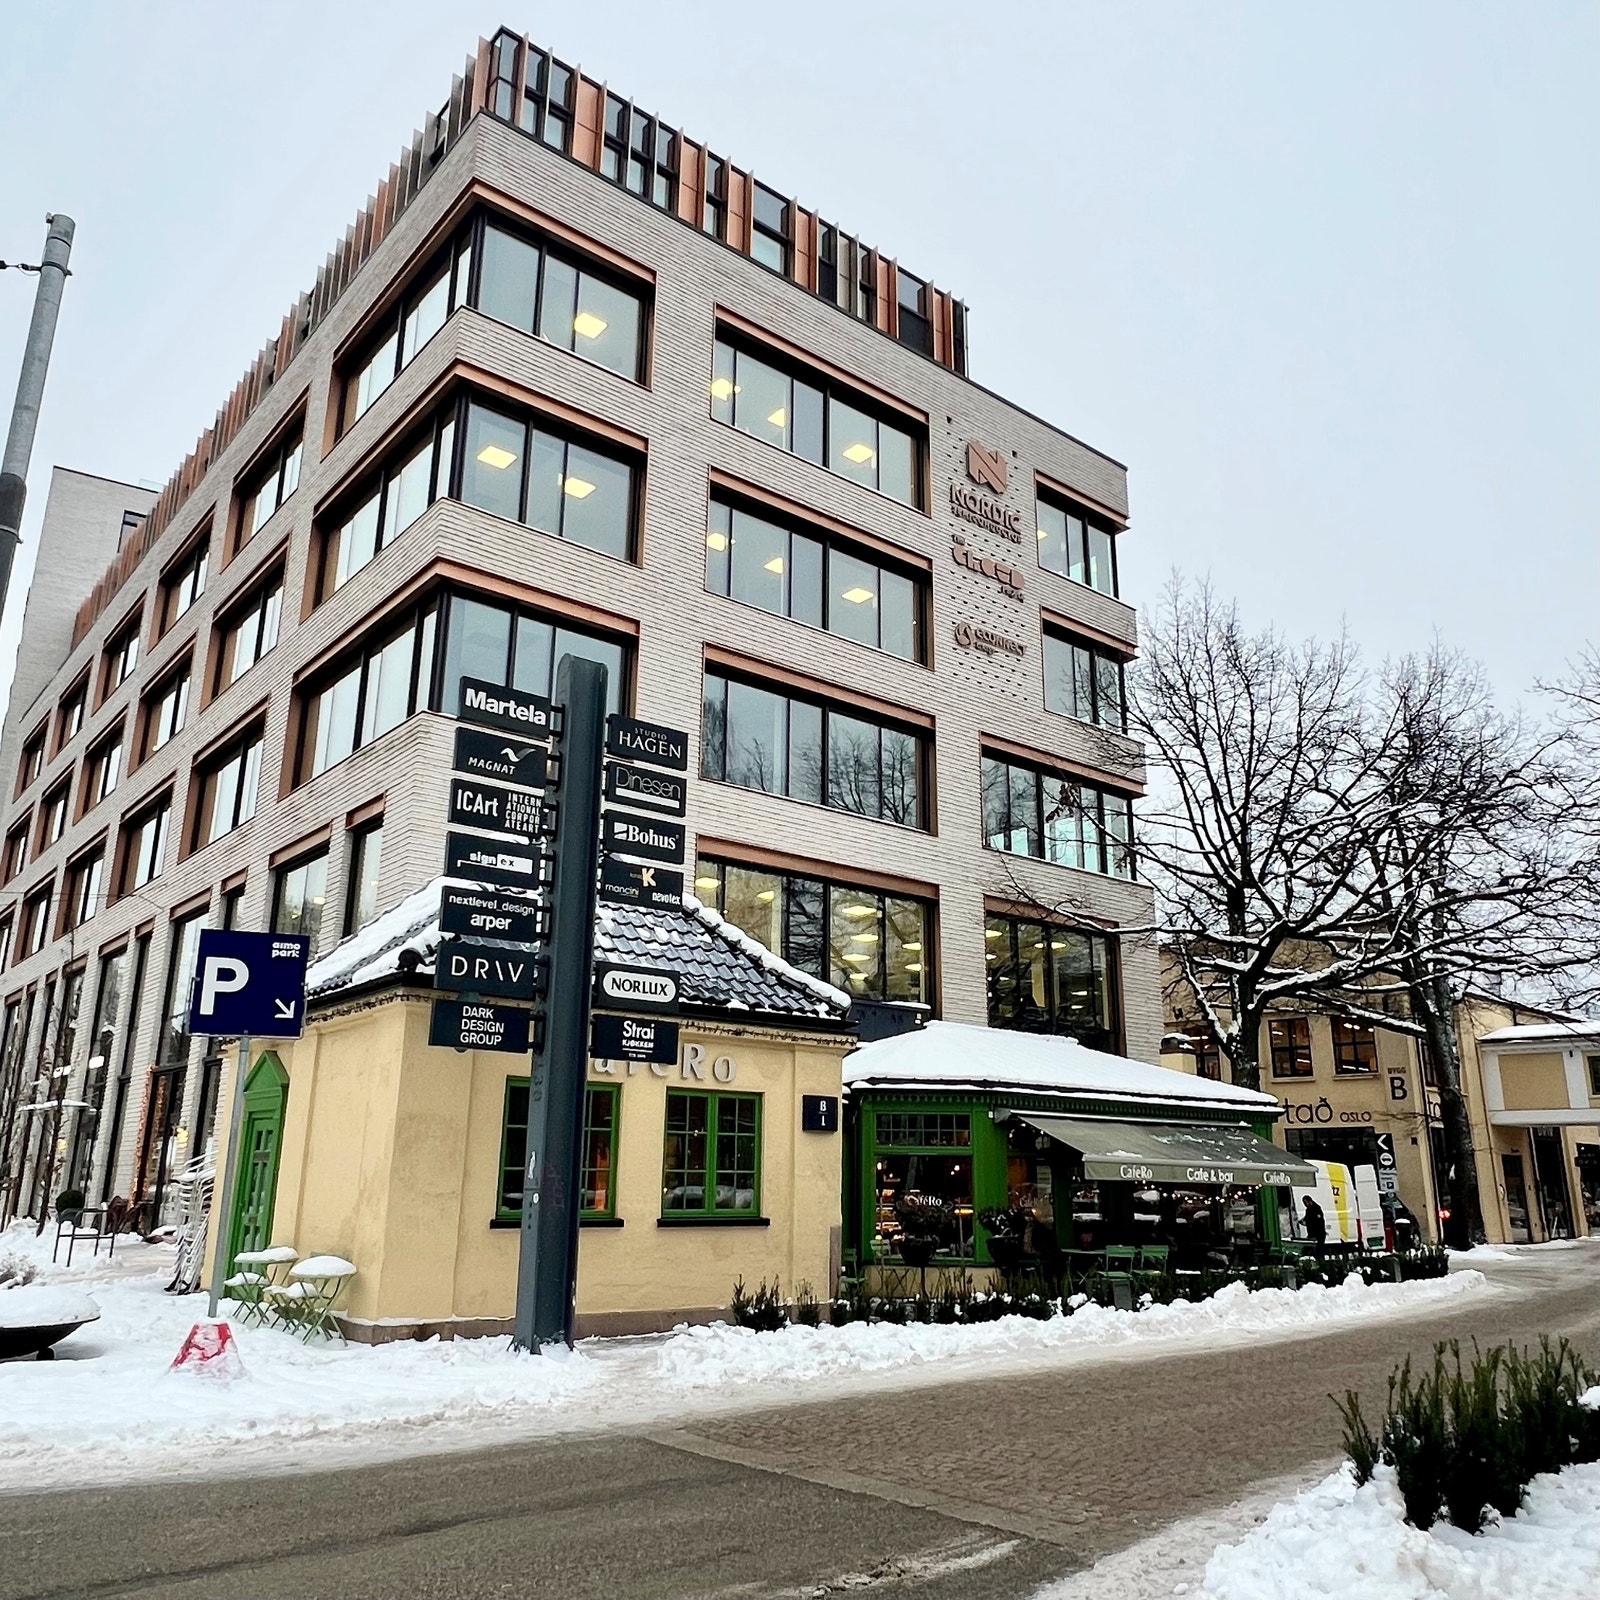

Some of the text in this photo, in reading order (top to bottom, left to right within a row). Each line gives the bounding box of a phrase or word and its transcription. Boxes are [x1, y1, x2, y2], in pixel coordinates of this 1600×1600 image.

[950, 484, 1022, 535] NORDIC
[464, 687, 547, 727] Martela
[634, 727, 667, 741] STUDIO
[619, 730, 681, 759] HAGEN
[467, 756, 516, 775] MAGNAT
[615, 766, 681, 799] Dinesen
[456, 788, 499, 817] ICArt
[506, 801, 541, 816] ATIONAL
[508, 792, 542, 807] INTERN
[505, 810, 540, 824] CORPOR
[627, 824, 677, 850] Bohus
[641, 867, 657, 887] K
[605, 884, 640, 896] mancini
[470, 913, 513, 931] arper
[271, 950, 300, 958] park
[272, 942, 301, 950] aimo
[199, 956, 250, 1015] P
[611, 977, 670, 997] NORLUX
[462, 1005, 494, 1019] DARK
[461, 1018, 505, 1034] DESIGN
[622, 1020, 655, 1040] Strai
[460, 1032, 502, 1046] GROUP
[1389, 1076, 1408, 1100] B
[819, 1100, 827, 1112] B
[1218, 1169, 1234, 1183] bar
